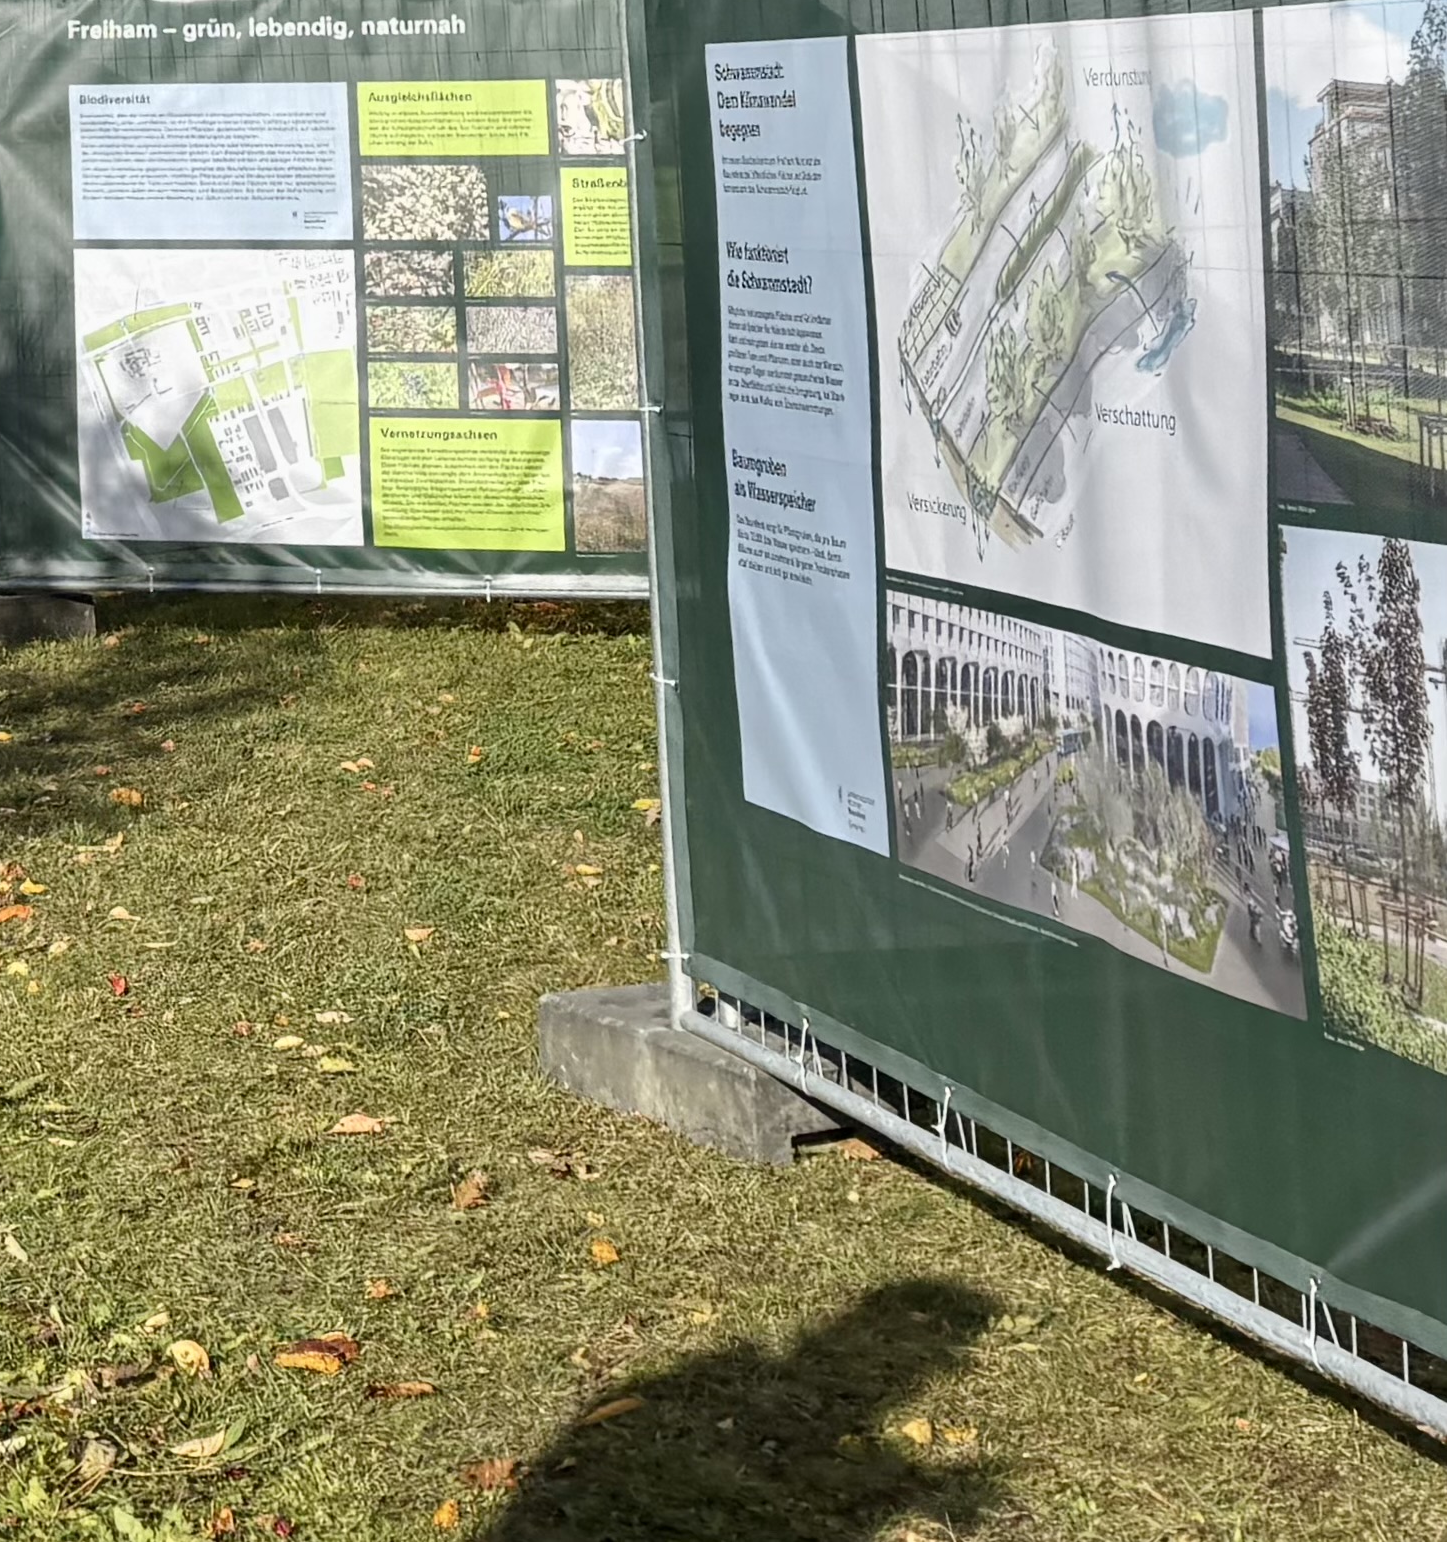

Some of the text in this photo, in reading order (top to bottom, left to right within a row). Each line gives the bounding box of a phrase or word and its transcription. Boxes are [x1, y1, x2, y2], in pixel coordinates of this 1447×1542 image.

[67, 19, 158, 40] Freiham
[182, 17, 242, 42] grün,
[248, 16, 354, 41] lebendig,
[361, 14, 466, 36] naturnah
[79, 93, 151, 106] Biodiversität
[368, 91, 473, 104] Ausgleichsflächen
[1095, 402, 1176, 436] Verschattung
[380, 427, 498, 441] Vernetzungsachsen
[907, 491, 967, 525] Versickerung
